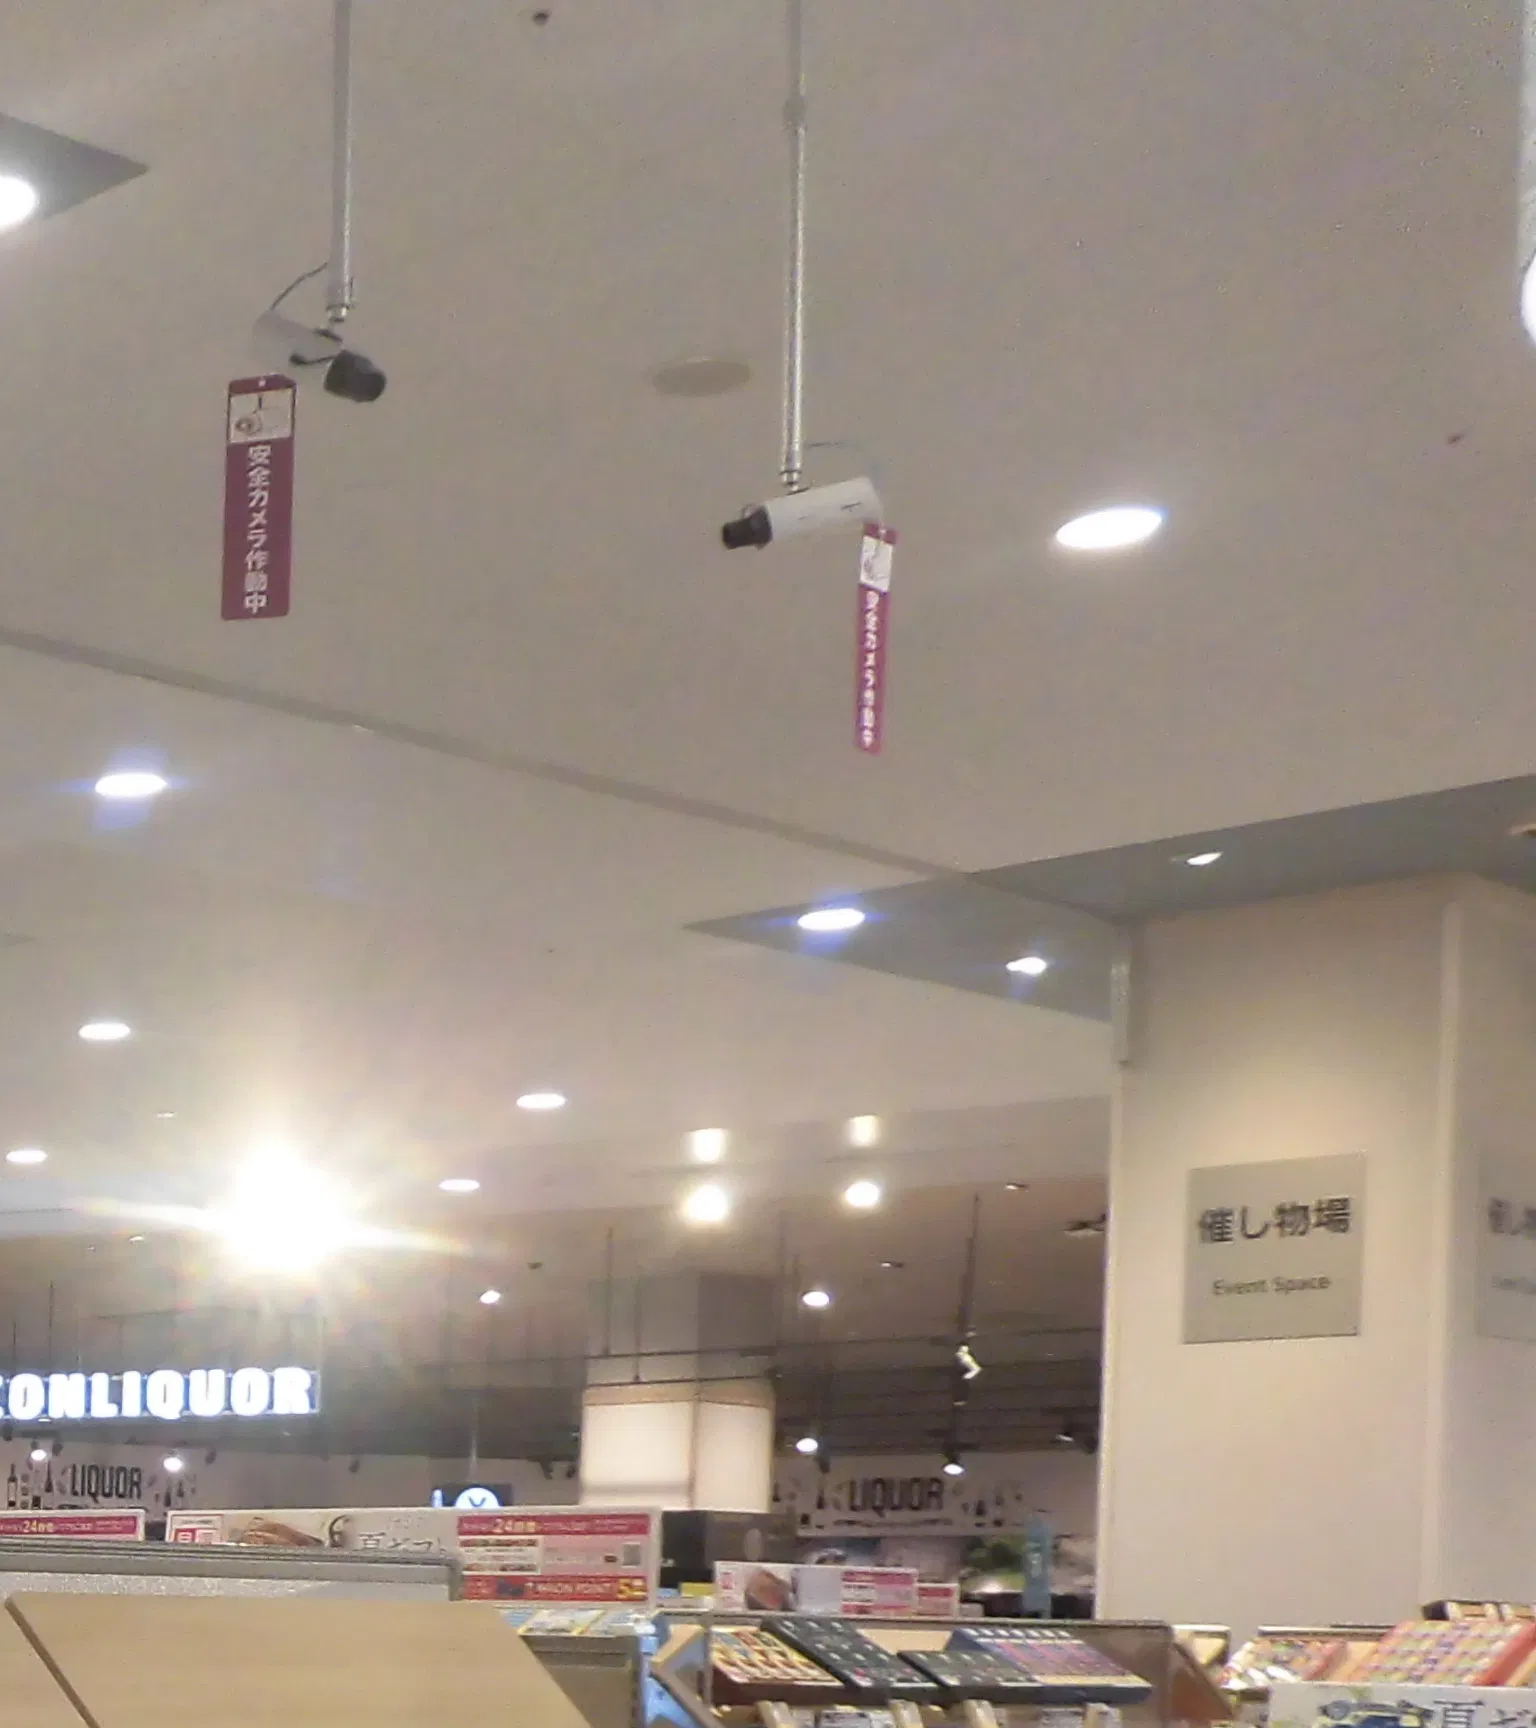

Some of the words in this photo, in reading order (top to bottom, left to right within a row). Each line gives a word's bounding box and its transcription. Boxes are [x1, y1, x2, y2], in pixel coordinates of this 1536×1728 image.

[244, 446, 272, 614] 安全カメラ作動中
[1199, 1197, 1351, 1243] 催し物場
[1213, 1279, 1269, 1296] Event
[1274, 1275, 1330, 1294] Space
[70, 1464, 142, 1501] LIQUOR
[849, 1477, 946, 1516] LIQUOR
